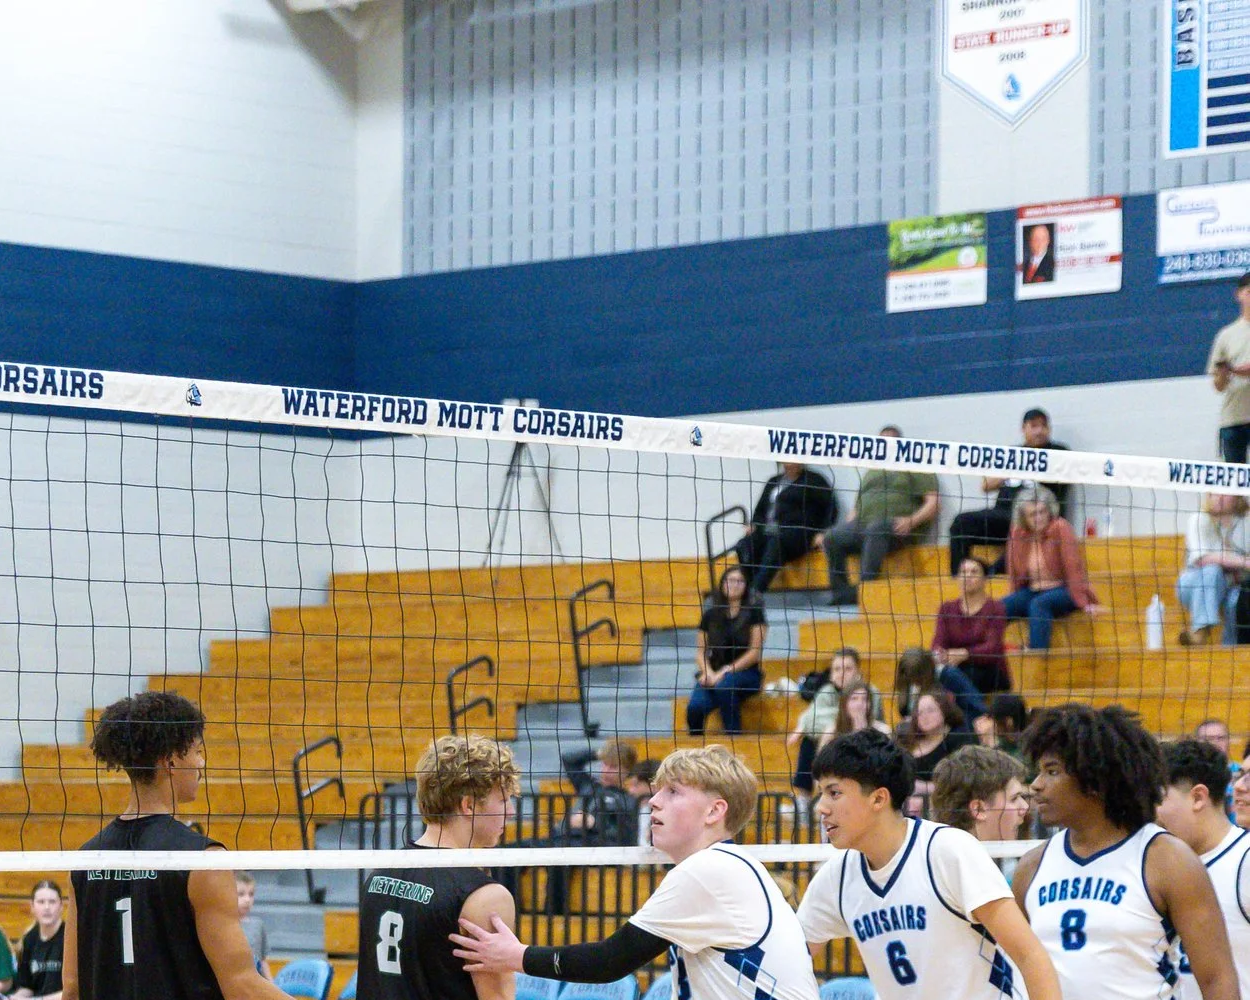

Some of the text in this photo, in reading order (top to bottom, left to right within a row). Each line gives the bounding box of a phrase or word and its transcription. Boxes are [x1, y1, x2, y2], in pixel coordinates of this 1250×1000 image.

[1177, 0, 1194, 65] BAS
[282, 388, 623, 441] WATERFORD MOTT CORSAIRS
[768, 429, 1048, 472] WATERFORD MOTT CORSAIRS
[368, 876, 434, 905] KETTERING
[1038, 876, 1128, 907] CORSAIRS
[115, 897, 135, 964] 1
[376, 910, 404, 975] 8
[853, 904, 927, 943] CORSAIRS
[1060, 908, 1087, 951] 8
[885, 939, 917, 986] 6
